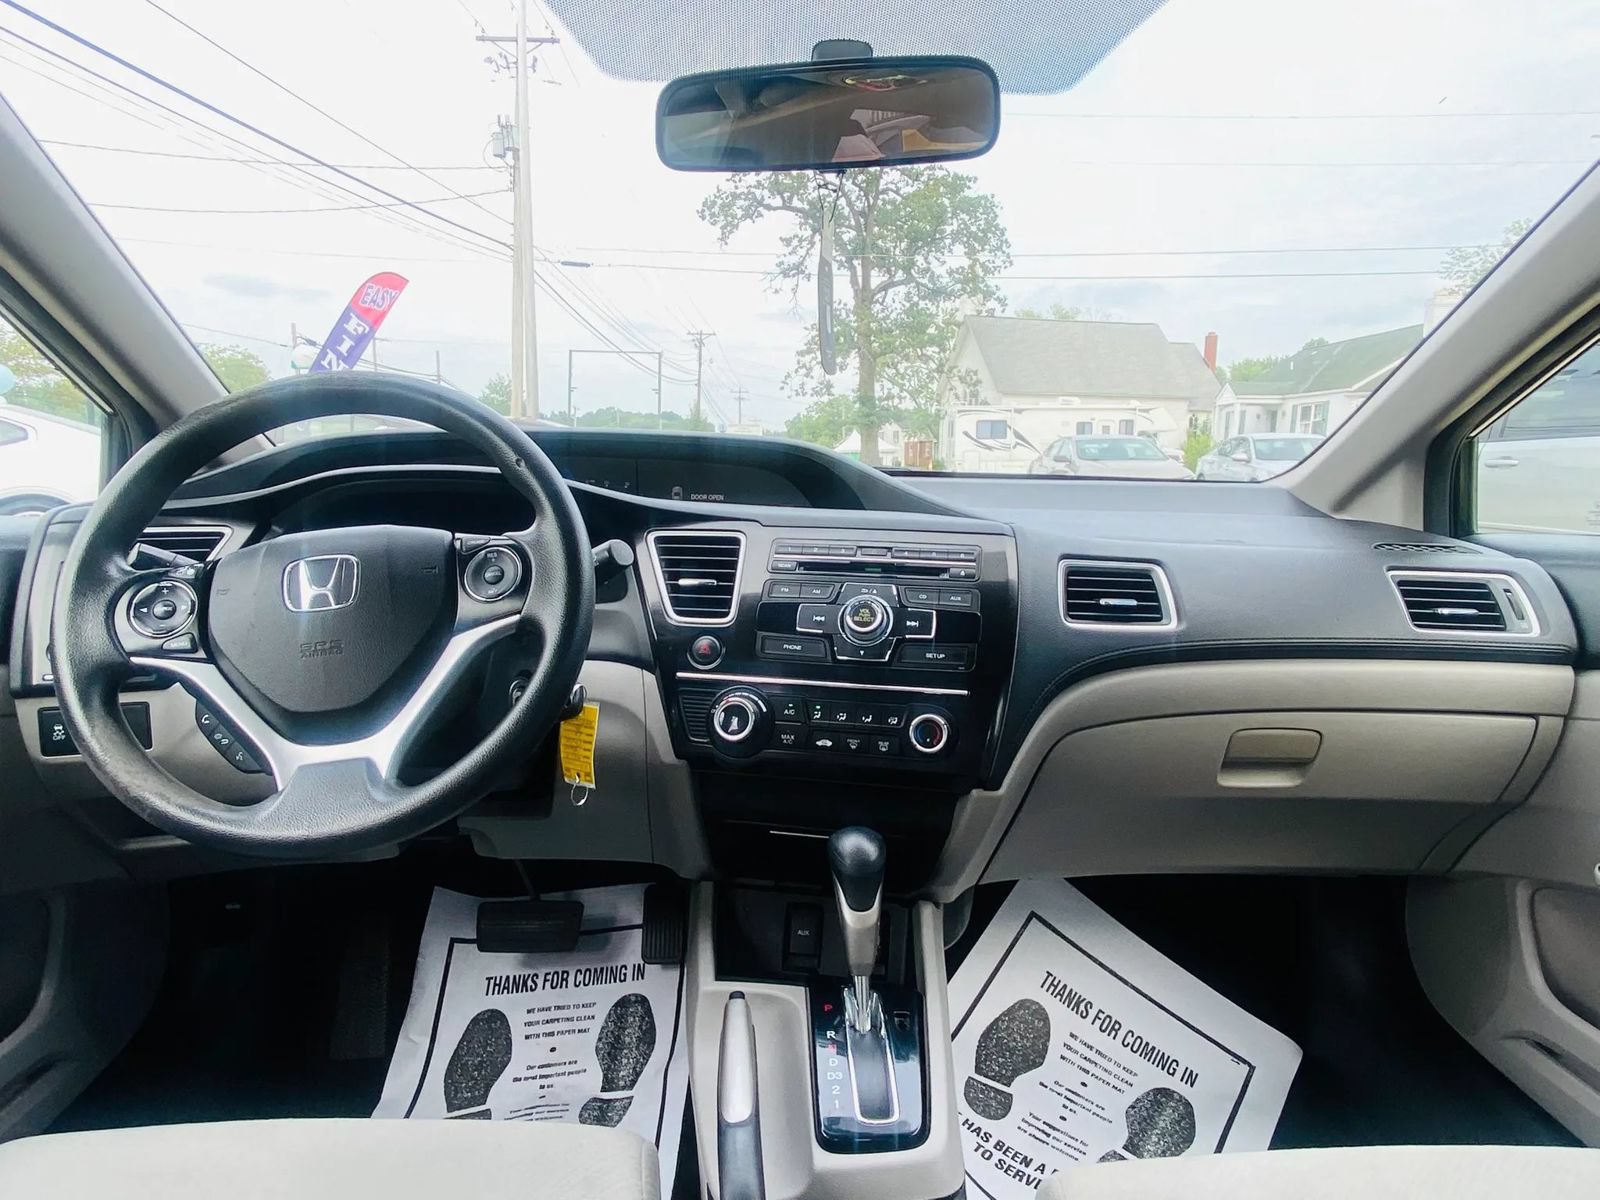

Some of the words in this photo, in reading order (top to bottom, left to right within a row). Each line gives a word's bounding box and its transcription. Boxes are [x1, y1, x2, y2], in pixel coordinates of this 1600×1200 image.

[360, 283, 400, 311] EASY
[690, 493, 708, 501] DOOR
[783, 643, 803, 651] PHONE
[485, 973, 539, 996] THANKS
[542, 970, 570, 991] FOR
[573, 964, 628, 988] COMING
[631, 963, 646, 981] IN
[537, 1005, 552, 1013] HAVE
[824, 1004, 833, 1012] P
[524, 1020, 540, 1028] YOUR
[541, 1016, 575, 1025] CARPETING
[556, 1028, 576, 1036] PAPER
[1040, 970, 1093, 1020] THANKS
[1091, 1008, 1122, 1041] FOR
[1121, 1029, 1179, 1077] COMING
[1179, 1066, 1199, 1088] IN
[826, 1031, 836, 1039] R
[1069, 1031, 1079, 1041] WE
[1079, 1039, 1095, 1052] HAVE
[1095, 1048, 1113, 1063] TRIED
[1113, 1060, 1122, 1069] TO
[1122, 1066, 1139, 1077] KEEP
[829, 1058, 838, 1067] D
[1063, 1042, 1080, 1056] YOUR
[1080, 1053, 1113, 1076] CARPETING
[1113, 1073, 1134, 1088] CLEAN
[827, 1072, 842, 1080] D3
[1060, 1054, 1076, 1067] WITH
[1091, 1072, 1111, 1087] PAPER
[1112, 1084, 1126, 1095] MAT
[831, 1085, 841, 1095] 2
[834, 1101, 840, 1109] 1
[961, 1118, 993, 1143] HAS
[993, 1139, 1034, 1169] BEEN
[1034, 1163, 1046, 1175] A
[973, 1141, 994, 1161] TO
